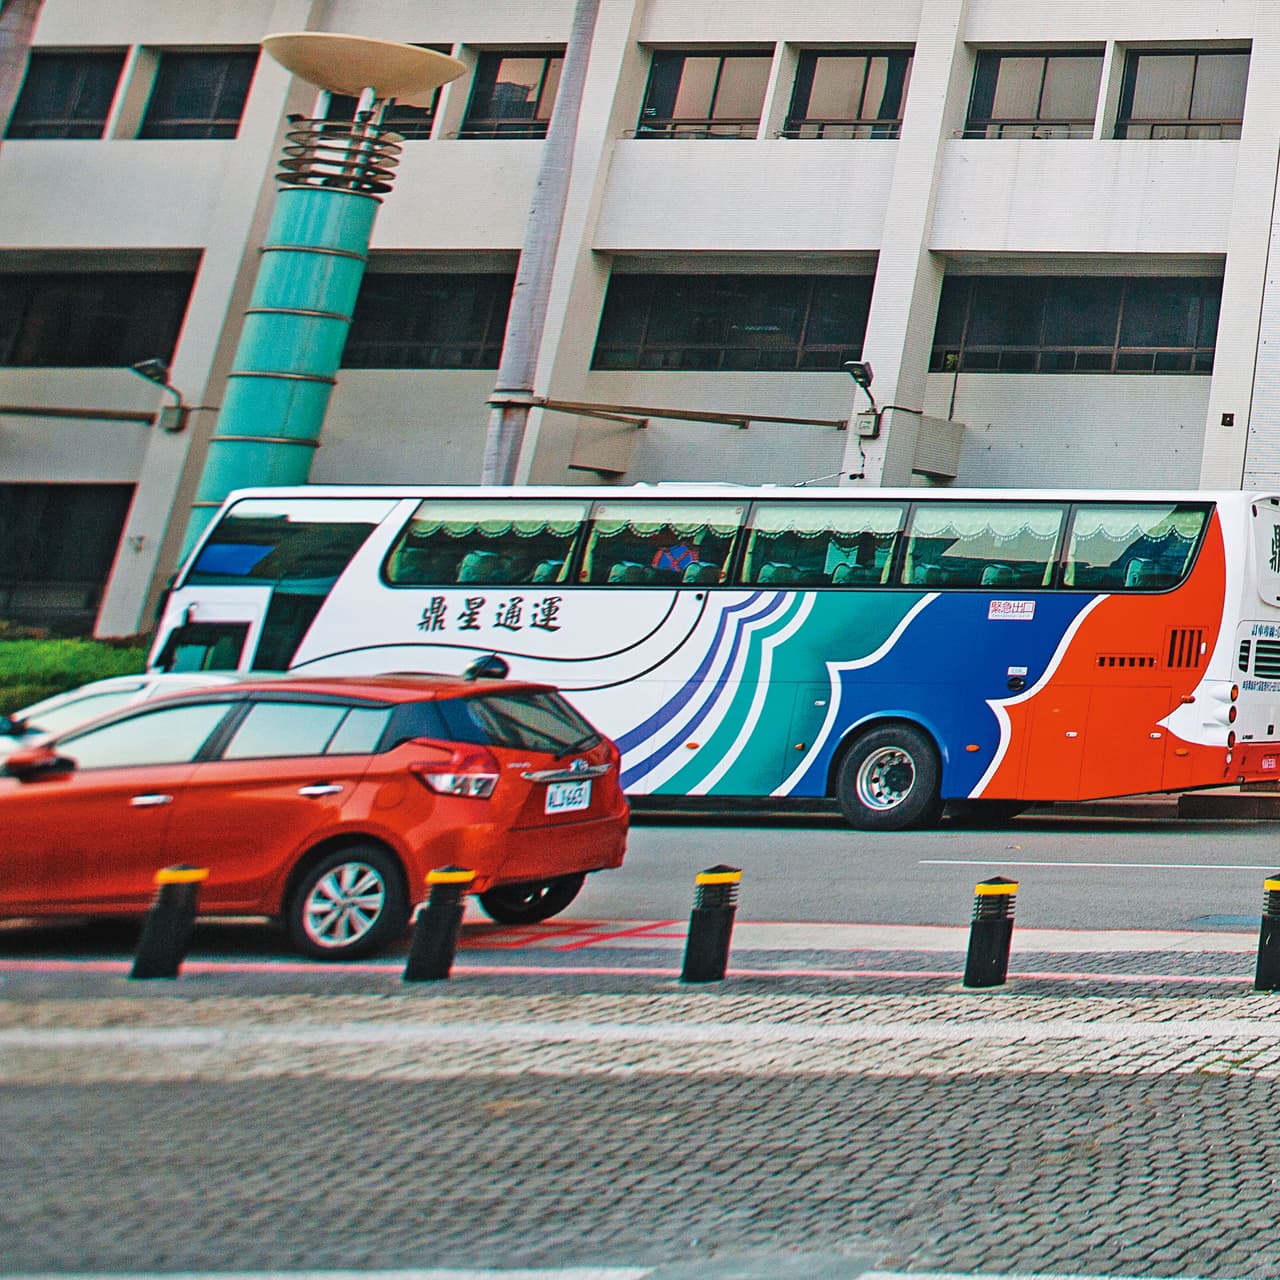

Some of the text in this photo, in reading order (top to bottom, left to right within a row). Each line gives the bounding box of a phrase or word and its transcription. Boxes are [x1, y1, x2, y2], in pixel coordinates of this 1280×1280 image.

[416, 595, 563, 632] 鼎星通運
[990, 602, 1035, 614] 緊急出口
